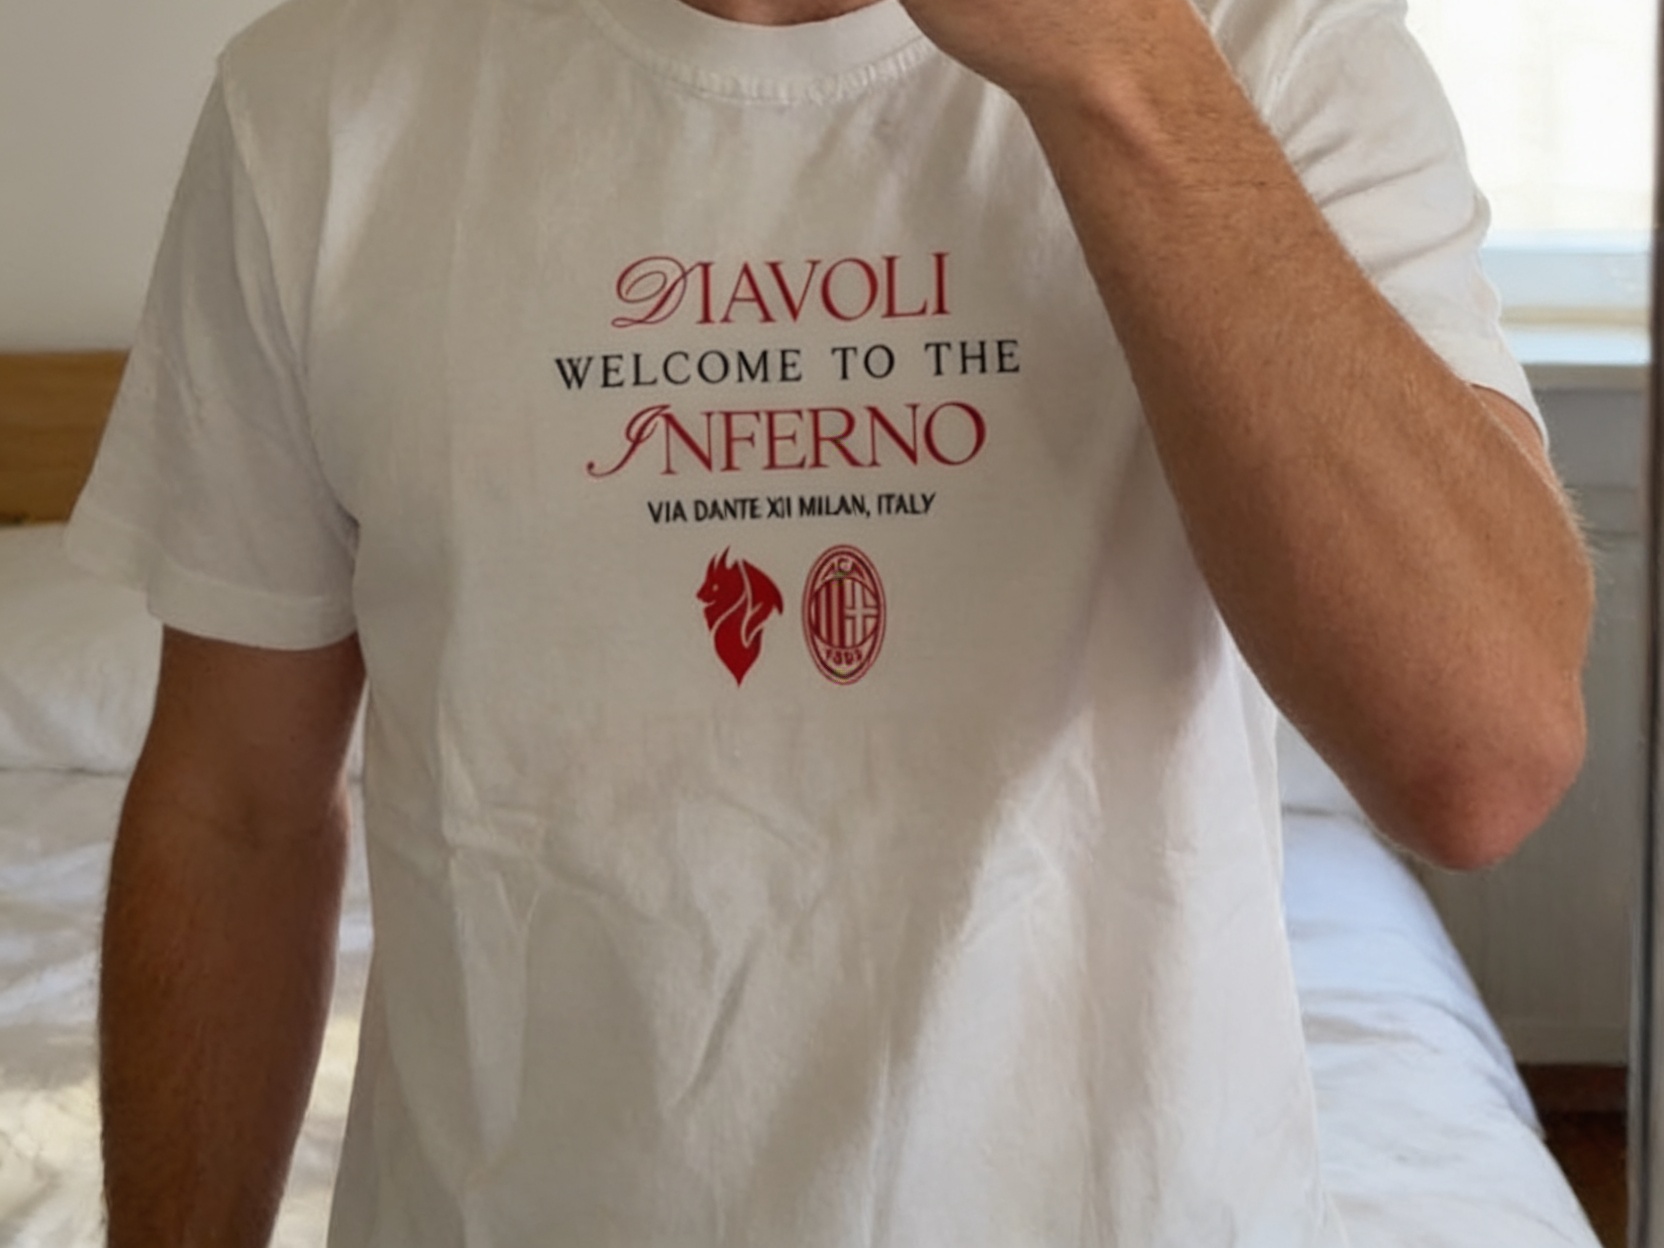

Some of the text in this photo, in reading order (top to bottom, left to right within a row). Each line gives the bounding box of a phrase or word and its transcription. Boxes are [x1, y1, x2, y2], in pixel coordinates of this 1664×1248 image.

[611, 251, 952, 328] DIAVOLI
[554, 339, 1022, 390] WELCOME TO THE
[586, 401, 987, 478] INFERNO
[647, 499, 688, 523] VIA
[694, 497, 762, 521] DANTE
[798, 493, 871, 519] MILAN,
[877, 491, 937, 515] ITALY
